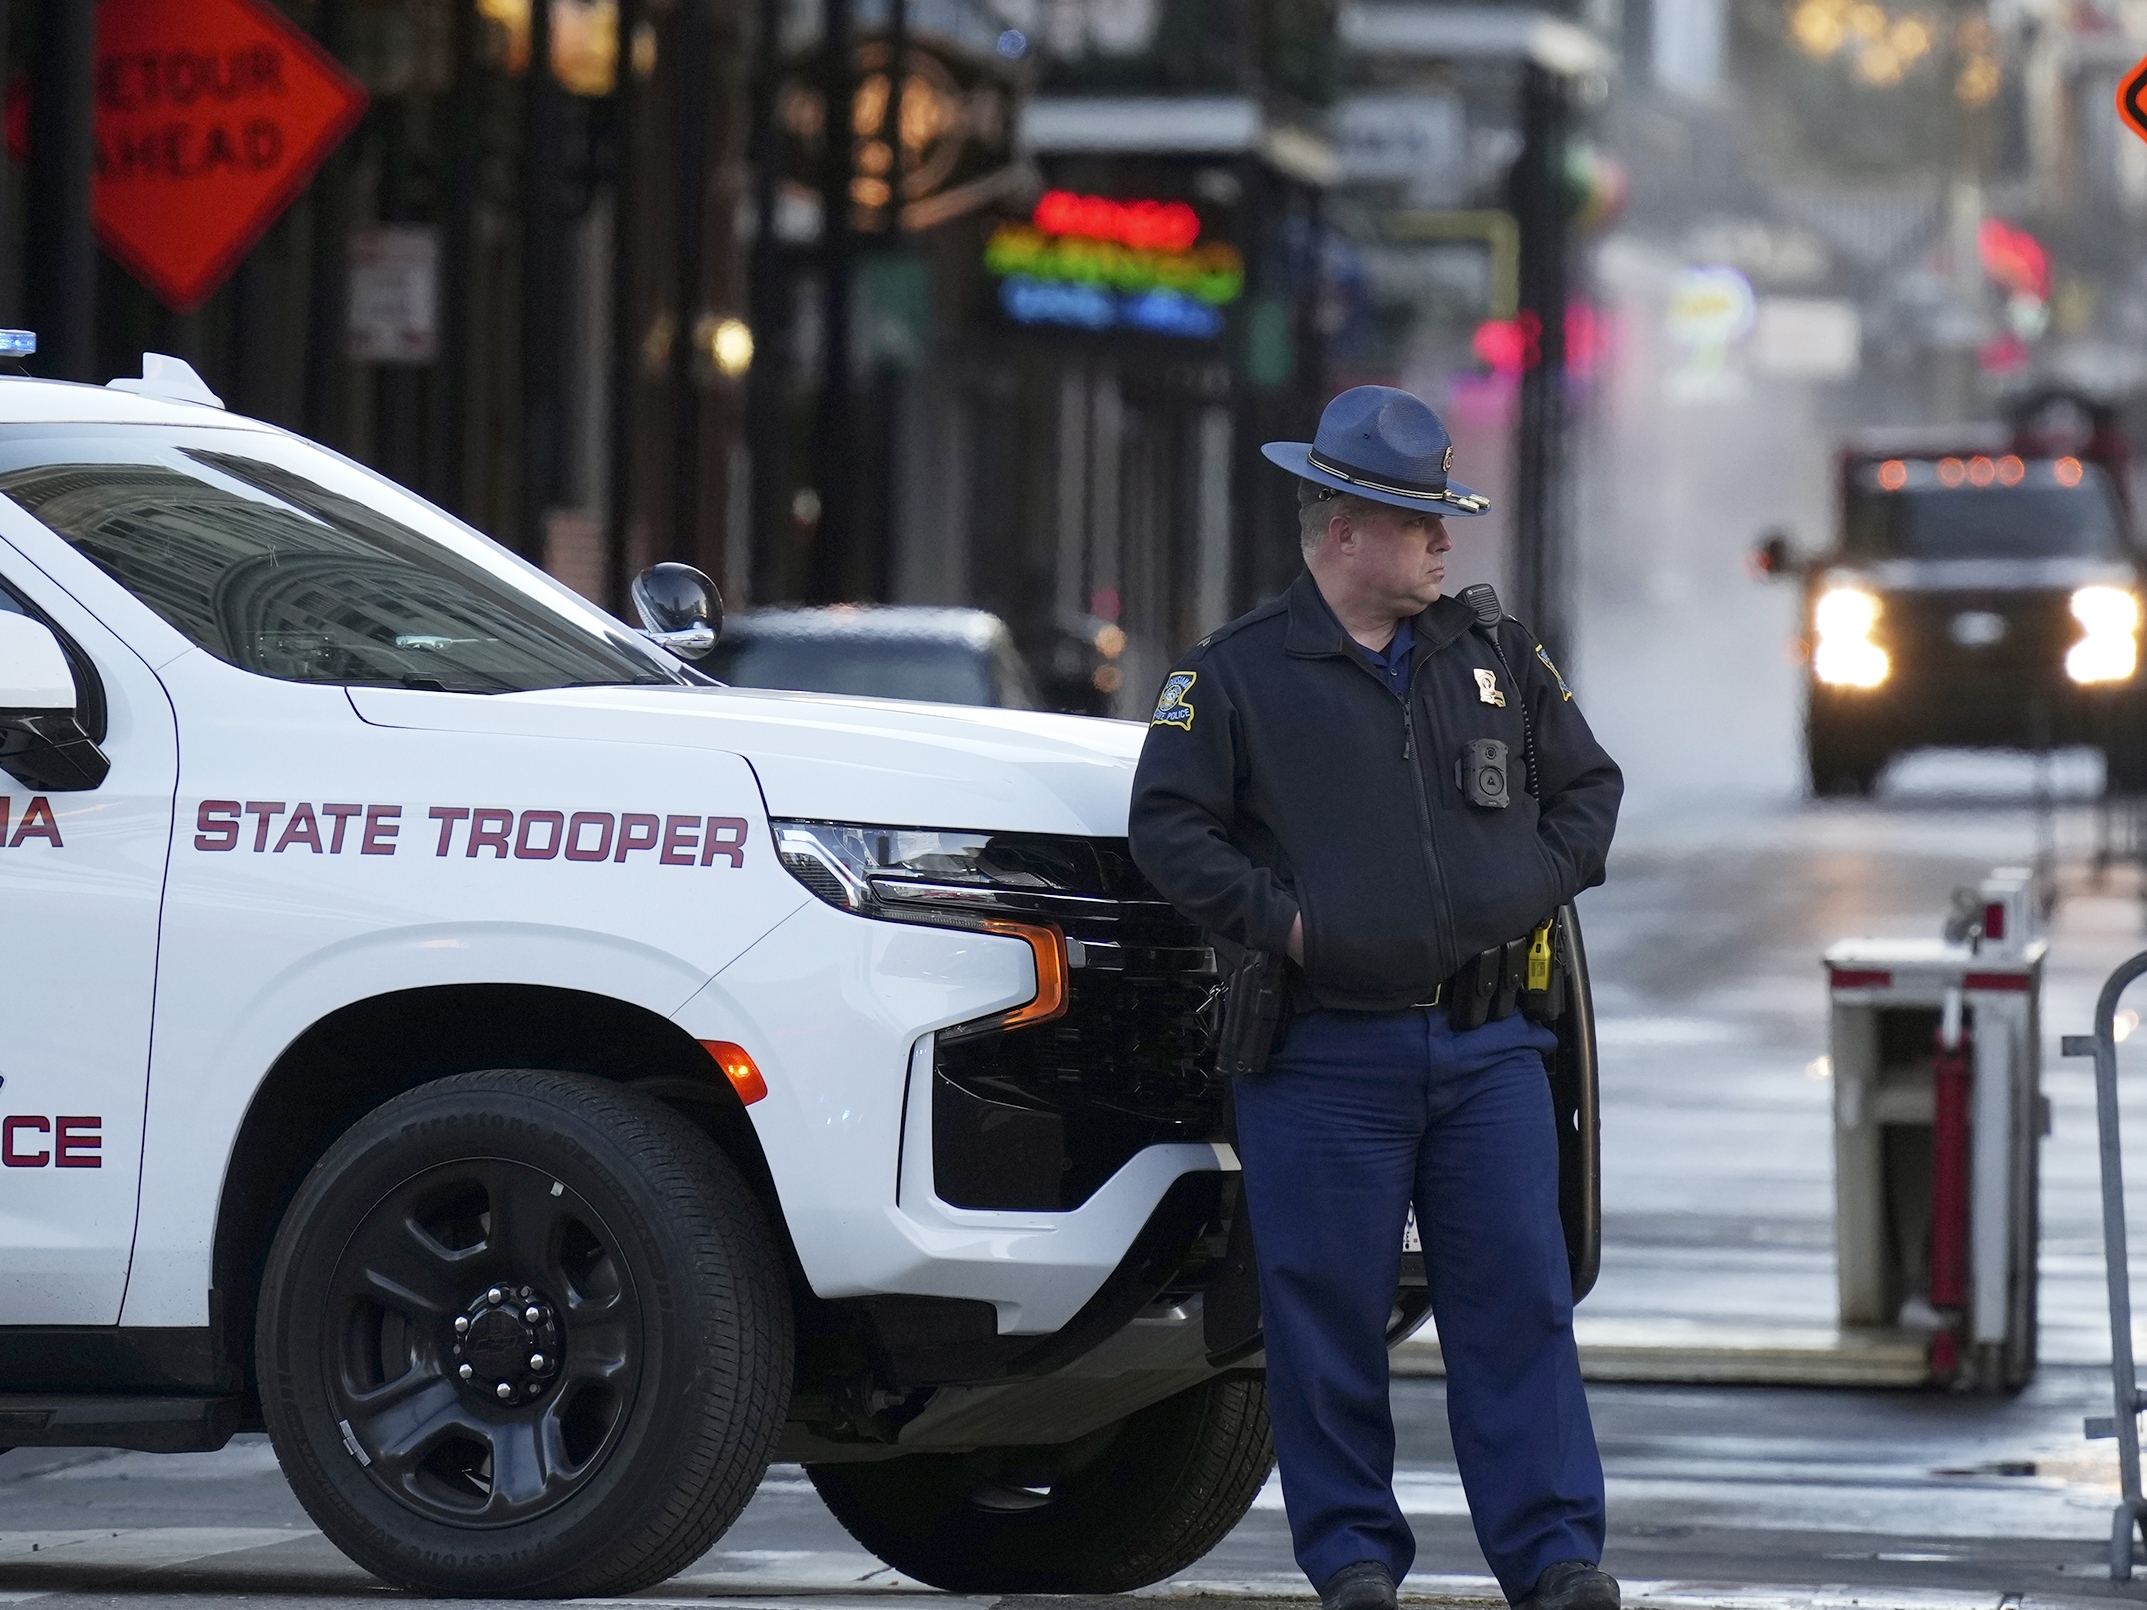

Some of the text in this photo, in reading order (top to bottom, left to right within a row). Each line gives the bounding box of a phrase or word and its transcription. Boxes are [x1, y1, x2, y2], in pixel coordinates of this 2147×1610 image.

[98, 41, 288, 112] ETOUR
[1166, 708, 1191, 720] POLICE
[193, 799, 749, 868] STATE TROOPER
[401, 1111, 540, 1142] Firestone
